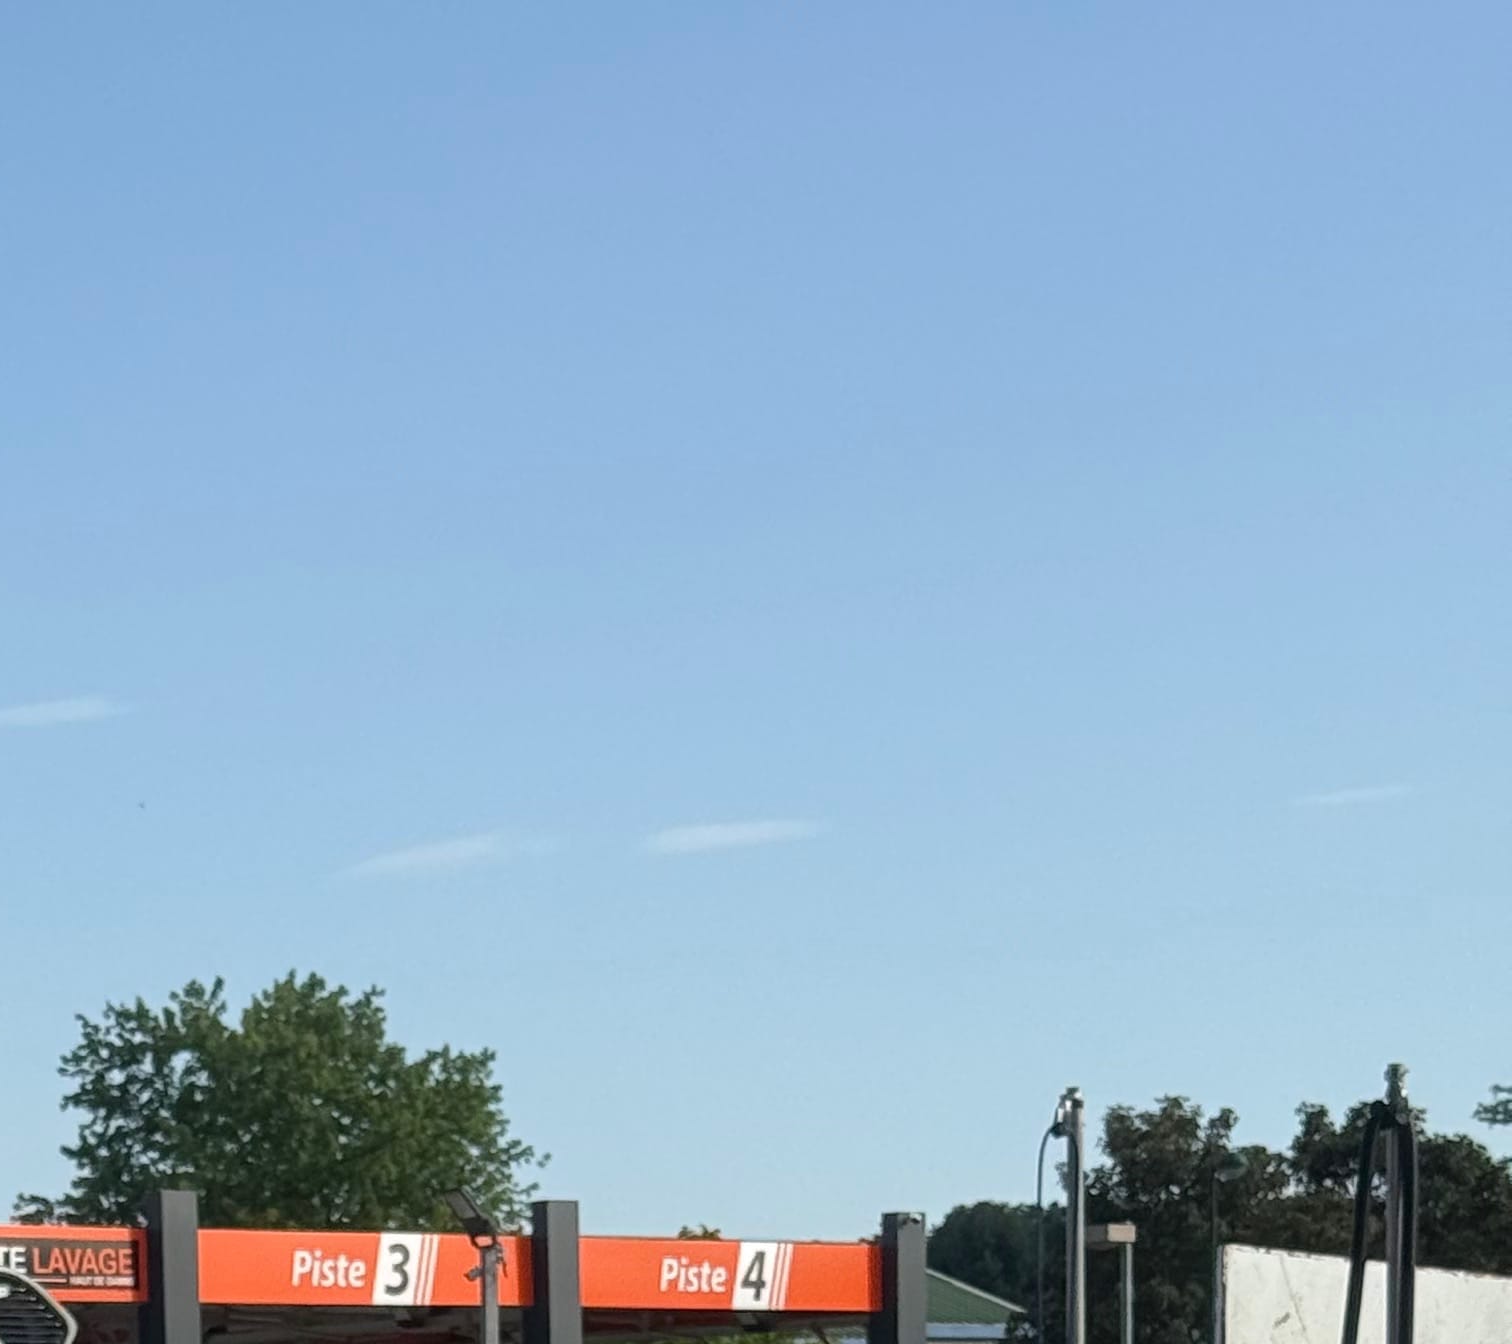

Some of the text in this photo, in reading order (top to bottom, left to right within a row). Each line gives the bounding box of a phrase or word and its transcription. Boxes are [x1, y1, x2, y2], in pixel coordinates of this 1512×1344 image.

[32, 1247, 134, 1275] LAVAGE
[291, 1243, 410, 1297] Piste 3
[659, 1250, 767, 1302] Piste 4
